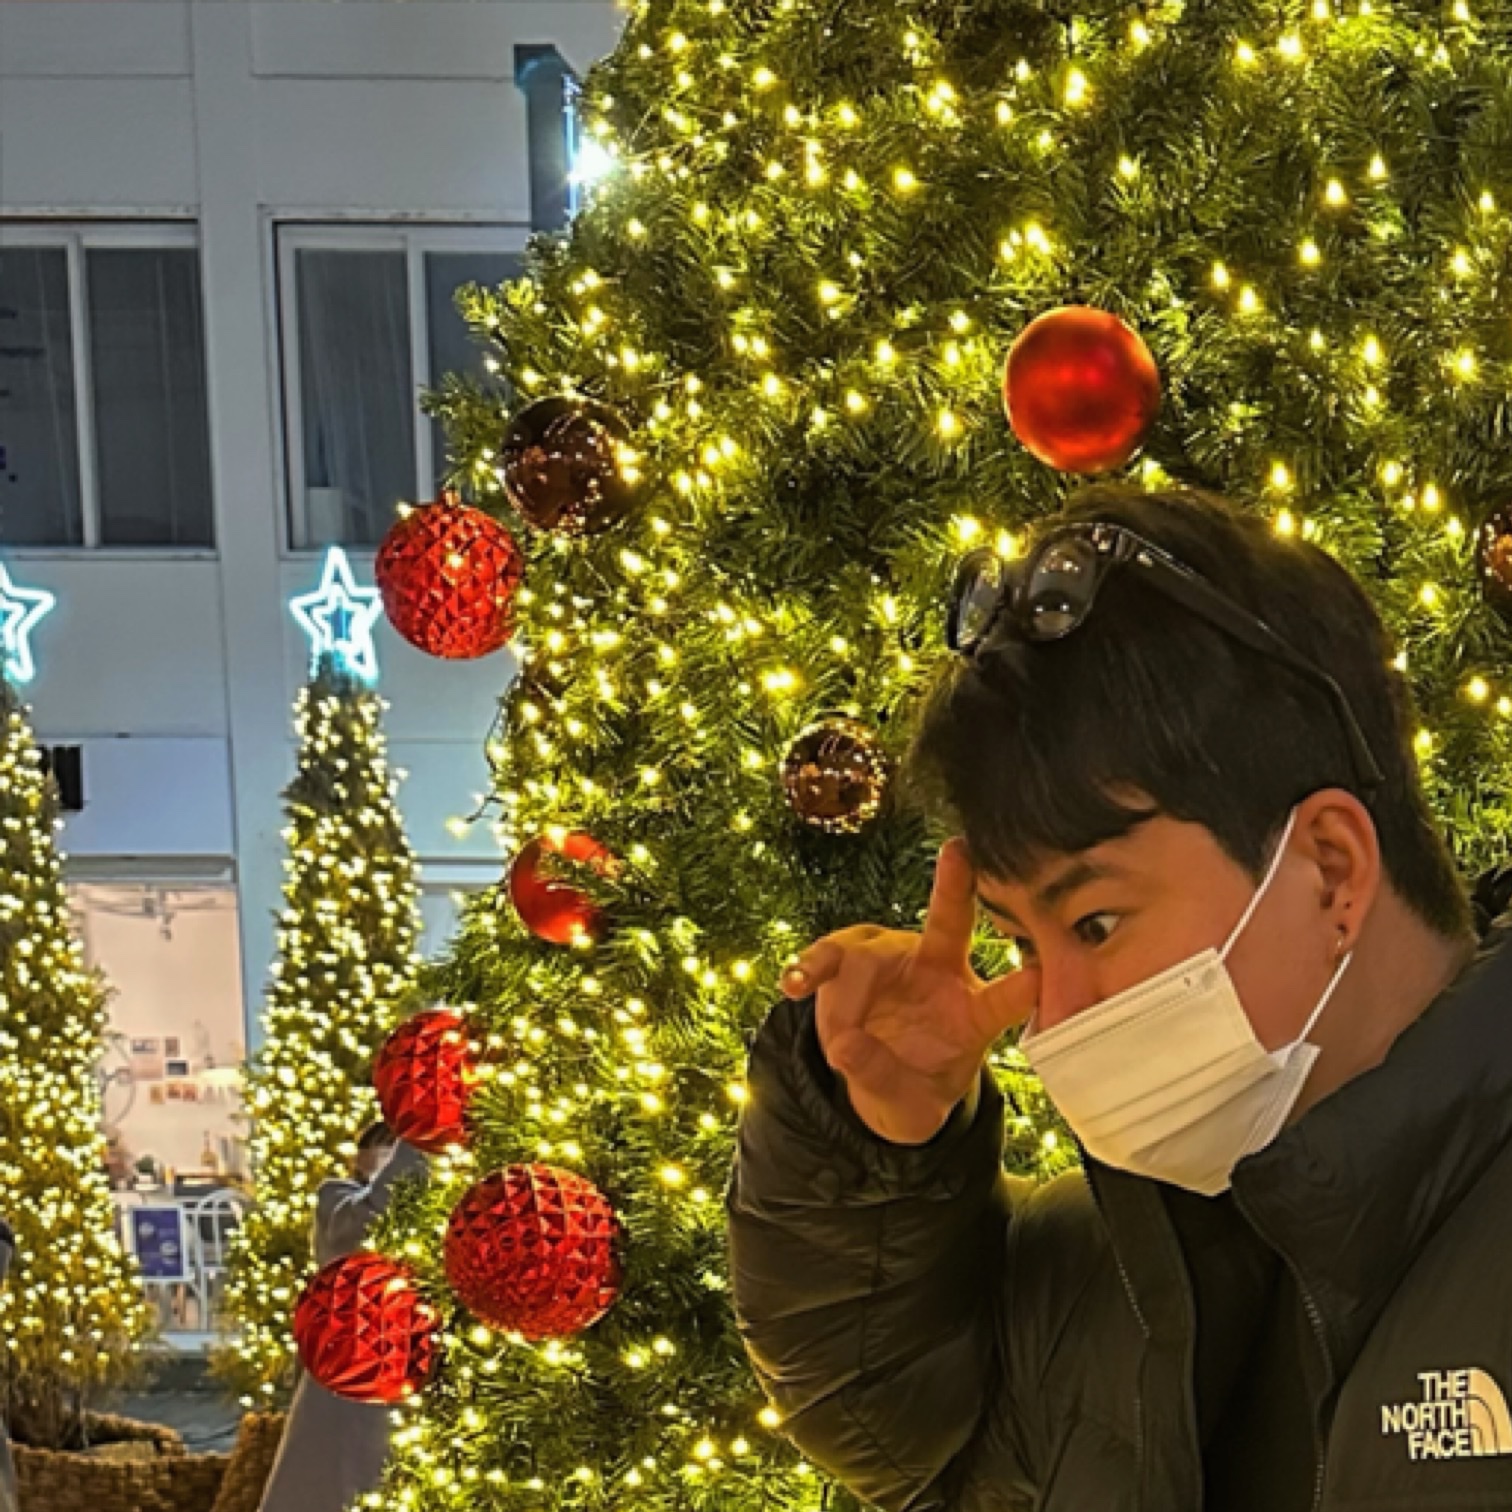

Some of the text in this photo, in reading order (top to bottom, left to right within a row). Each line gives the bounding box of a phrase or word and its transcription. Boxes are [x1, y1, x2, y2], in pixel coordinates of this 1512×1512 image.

[1417, 1370, 1469, 1400] THE
[1381, 1402, 1469, 1433] NORTH
[1408, 1430, 1471, 1459] FACE
